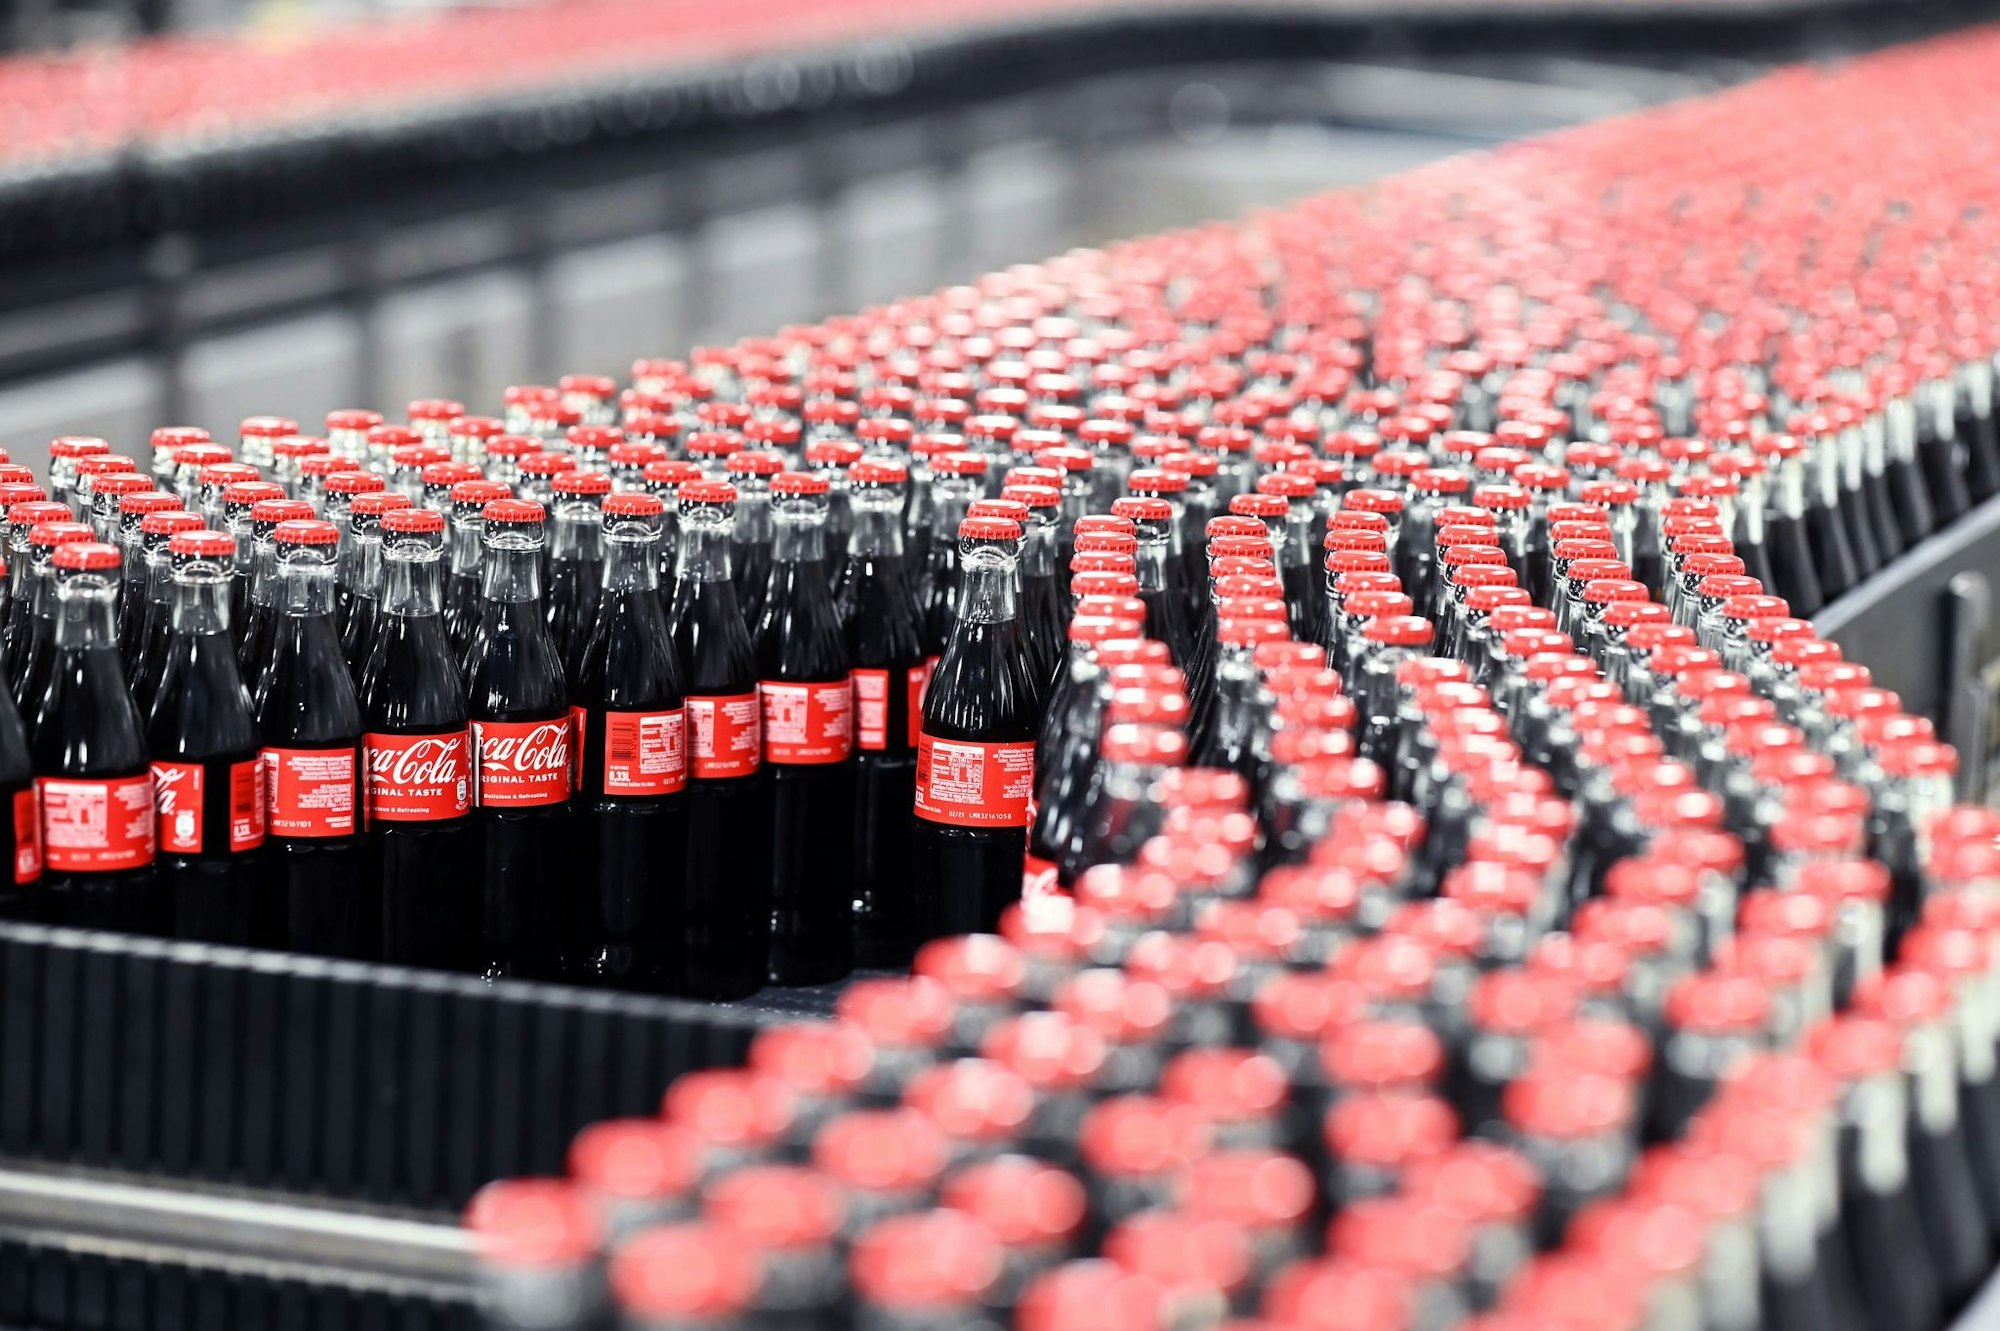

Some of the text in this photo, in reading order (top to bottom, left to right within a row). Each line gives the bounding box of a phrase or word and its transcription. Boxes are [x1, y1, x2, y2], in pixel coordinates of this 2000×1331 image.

[481, 772, 558, 784] RIGINAL TASTE
[371, 787, 443, 797] GINAL TASTE
[518, 792, 549, 800] Refreshing
[948, 810, 1012, 820] 02/25 LMR32161058
